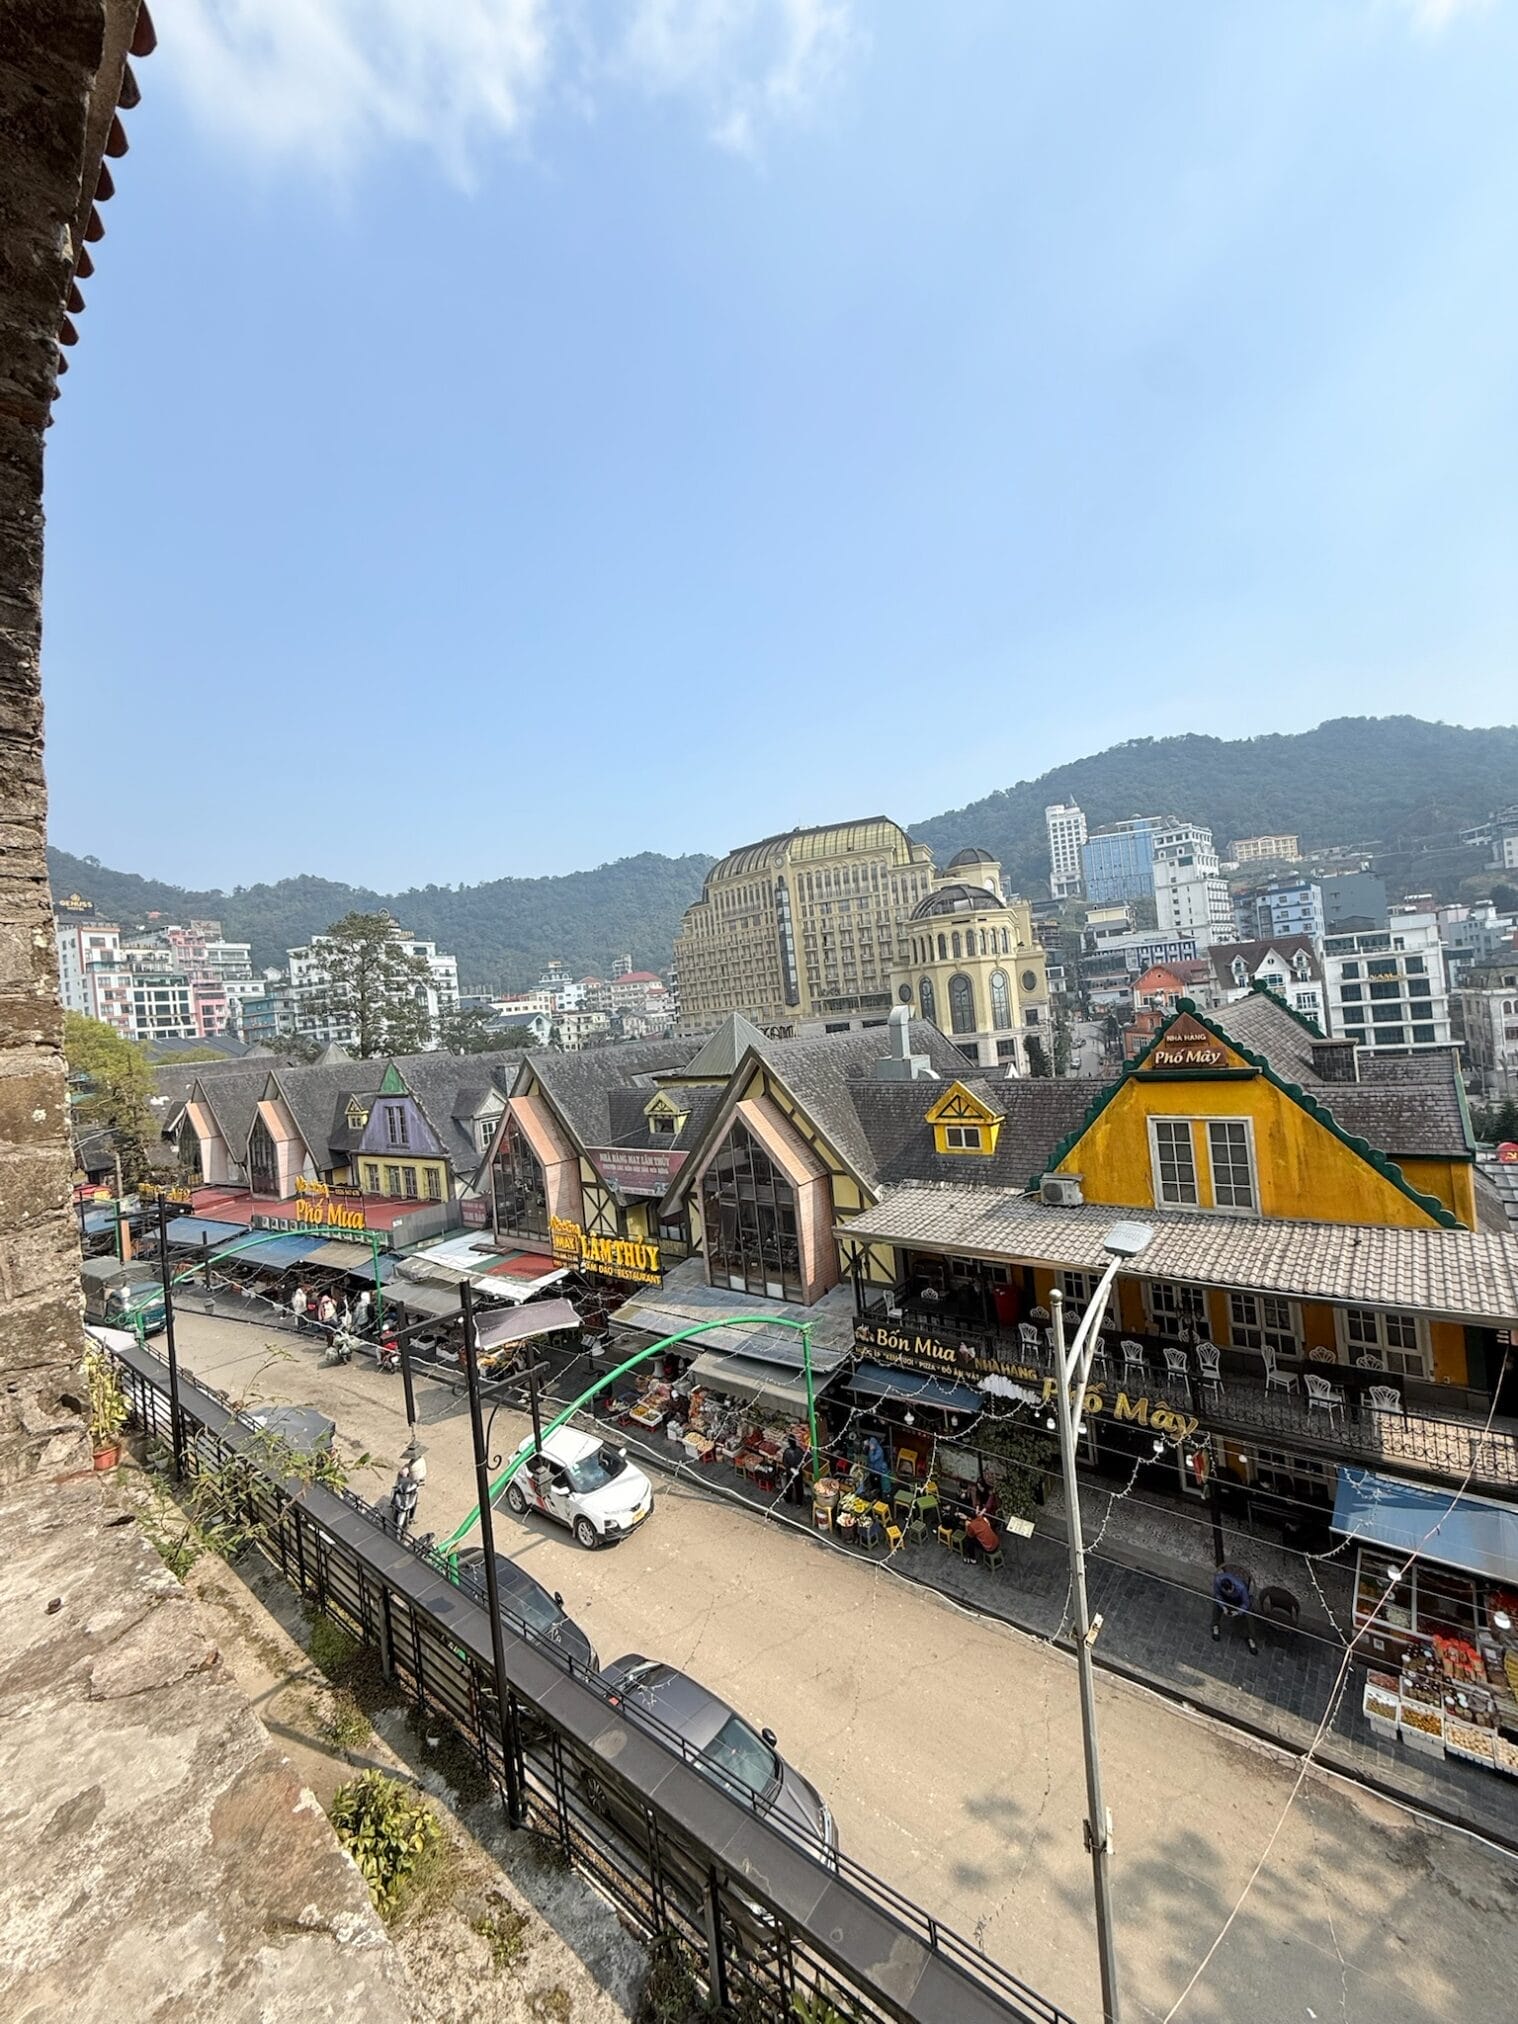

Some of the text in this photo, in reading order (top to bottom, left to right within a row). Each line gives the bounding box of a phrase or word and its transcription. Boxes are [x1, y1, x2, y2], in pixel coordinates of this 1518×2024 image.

[1155, 1048, 1221, 1065] Phố Mây
[296, 1197, 365, 1230] Phố Mưa
[580, 1230, 613, 1264] LÂM
[877, 1328, 957, 1362] Bốn Mùa
[1042, 1377, 1199, 1441] Pố Mây
